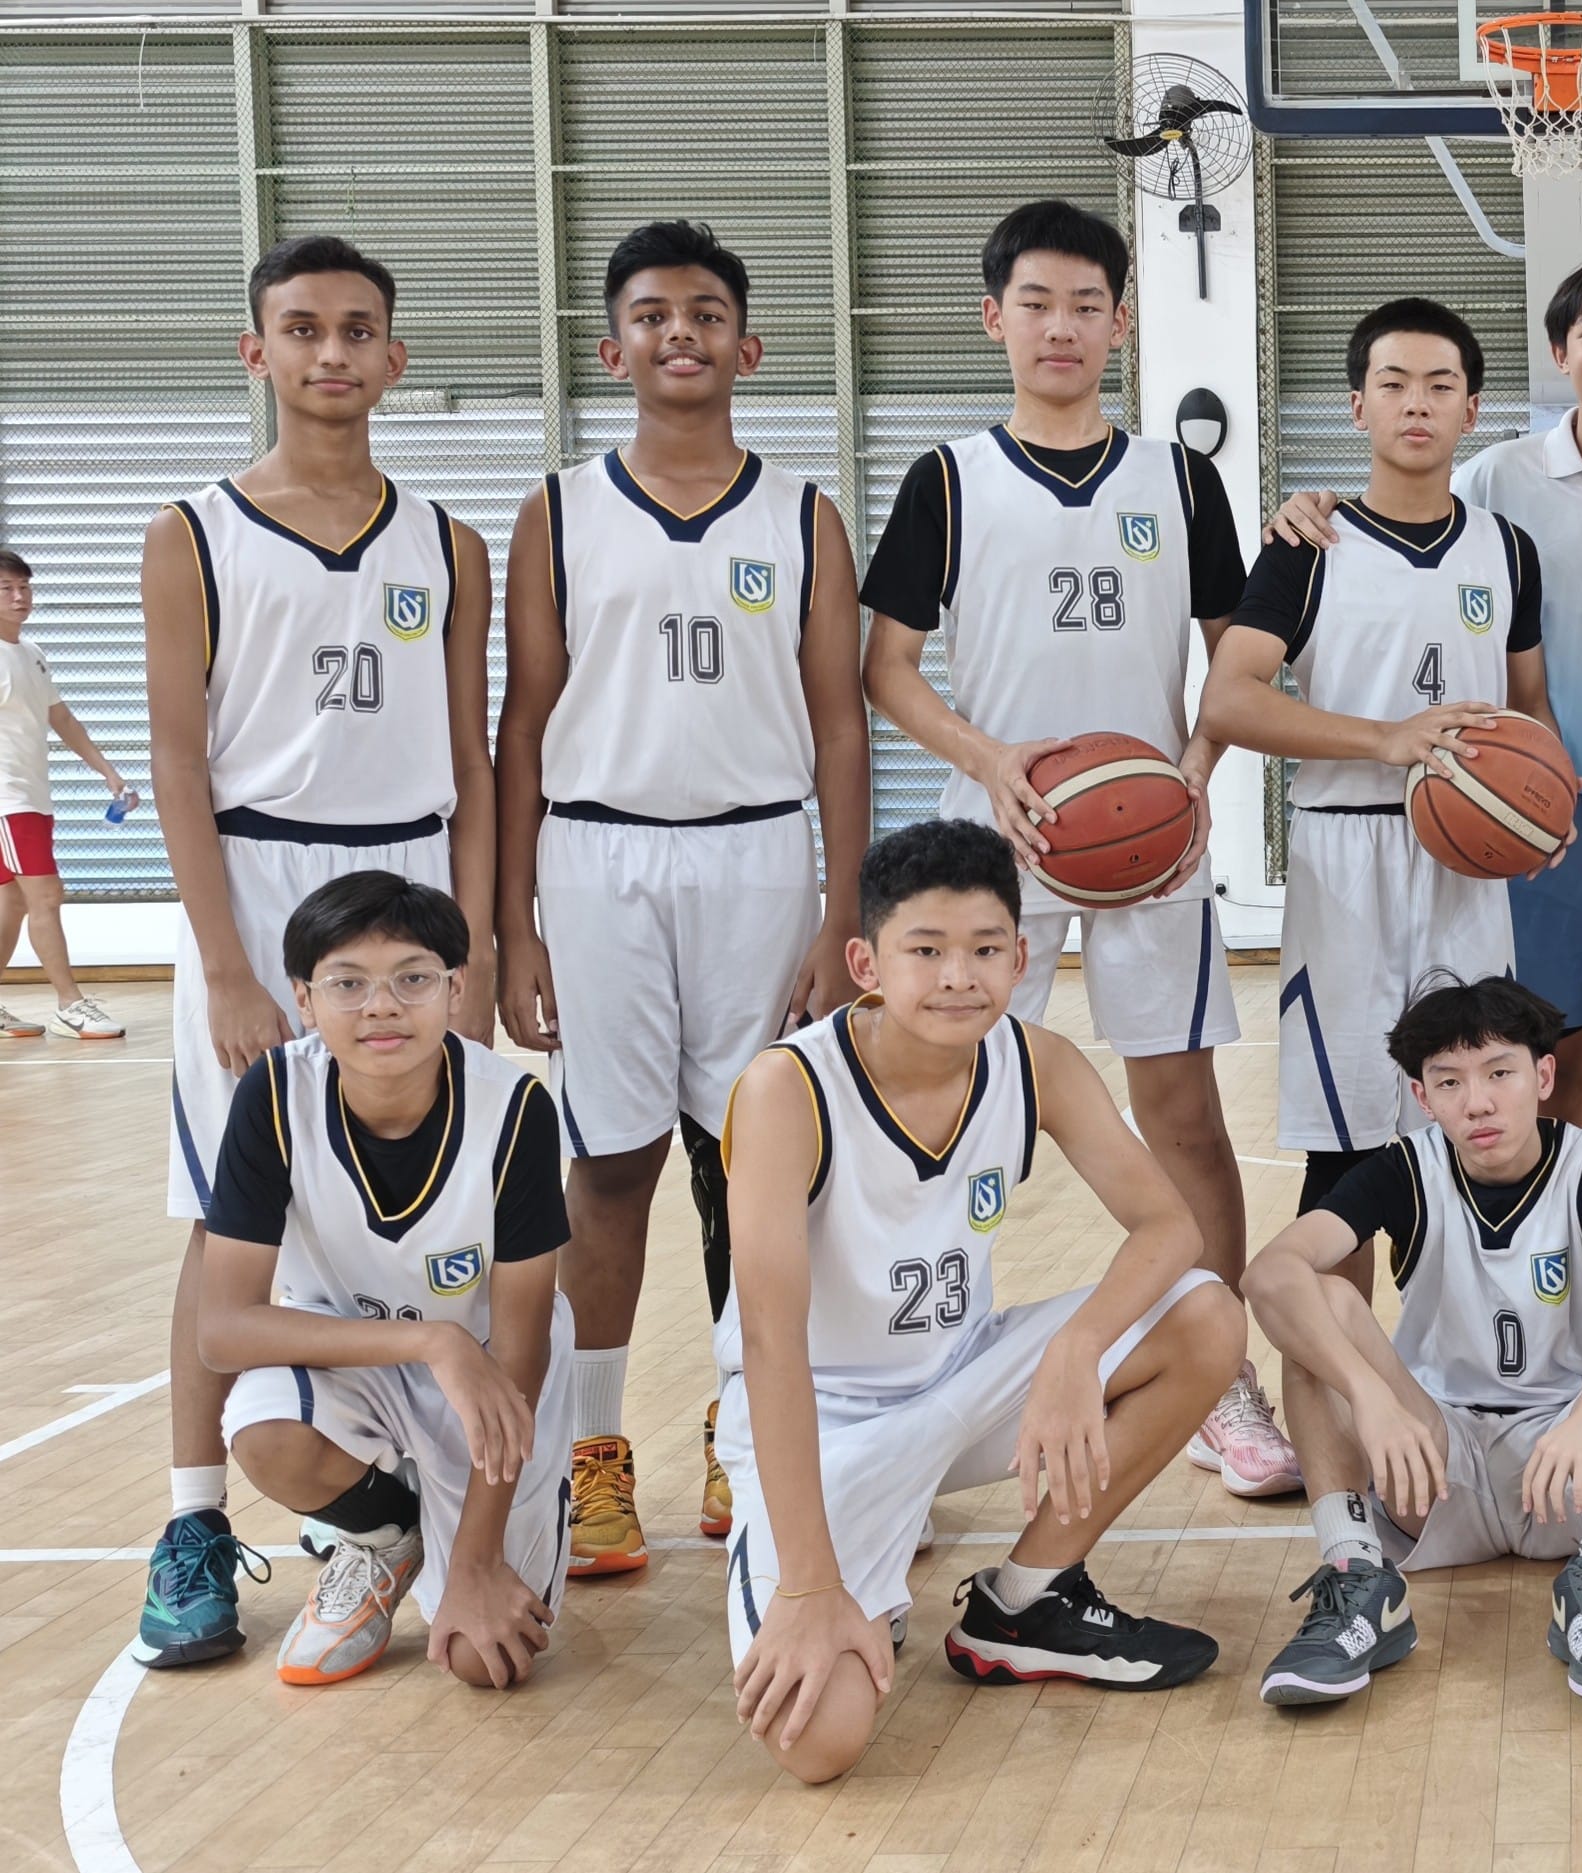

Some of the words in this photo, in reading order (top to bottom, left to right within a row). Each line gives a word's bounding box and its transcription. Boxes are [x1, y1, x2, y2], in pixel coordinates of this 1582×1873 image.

[1048, 566, 1126, 632] 28
[312, 641, 384, 716] 20
[659, 613, 725, 684] 10
[1412, 643, 1446, 706] 4
[888, 1247, 970, 1335] 23
[1493, 1308, 1527, 1377] 0
